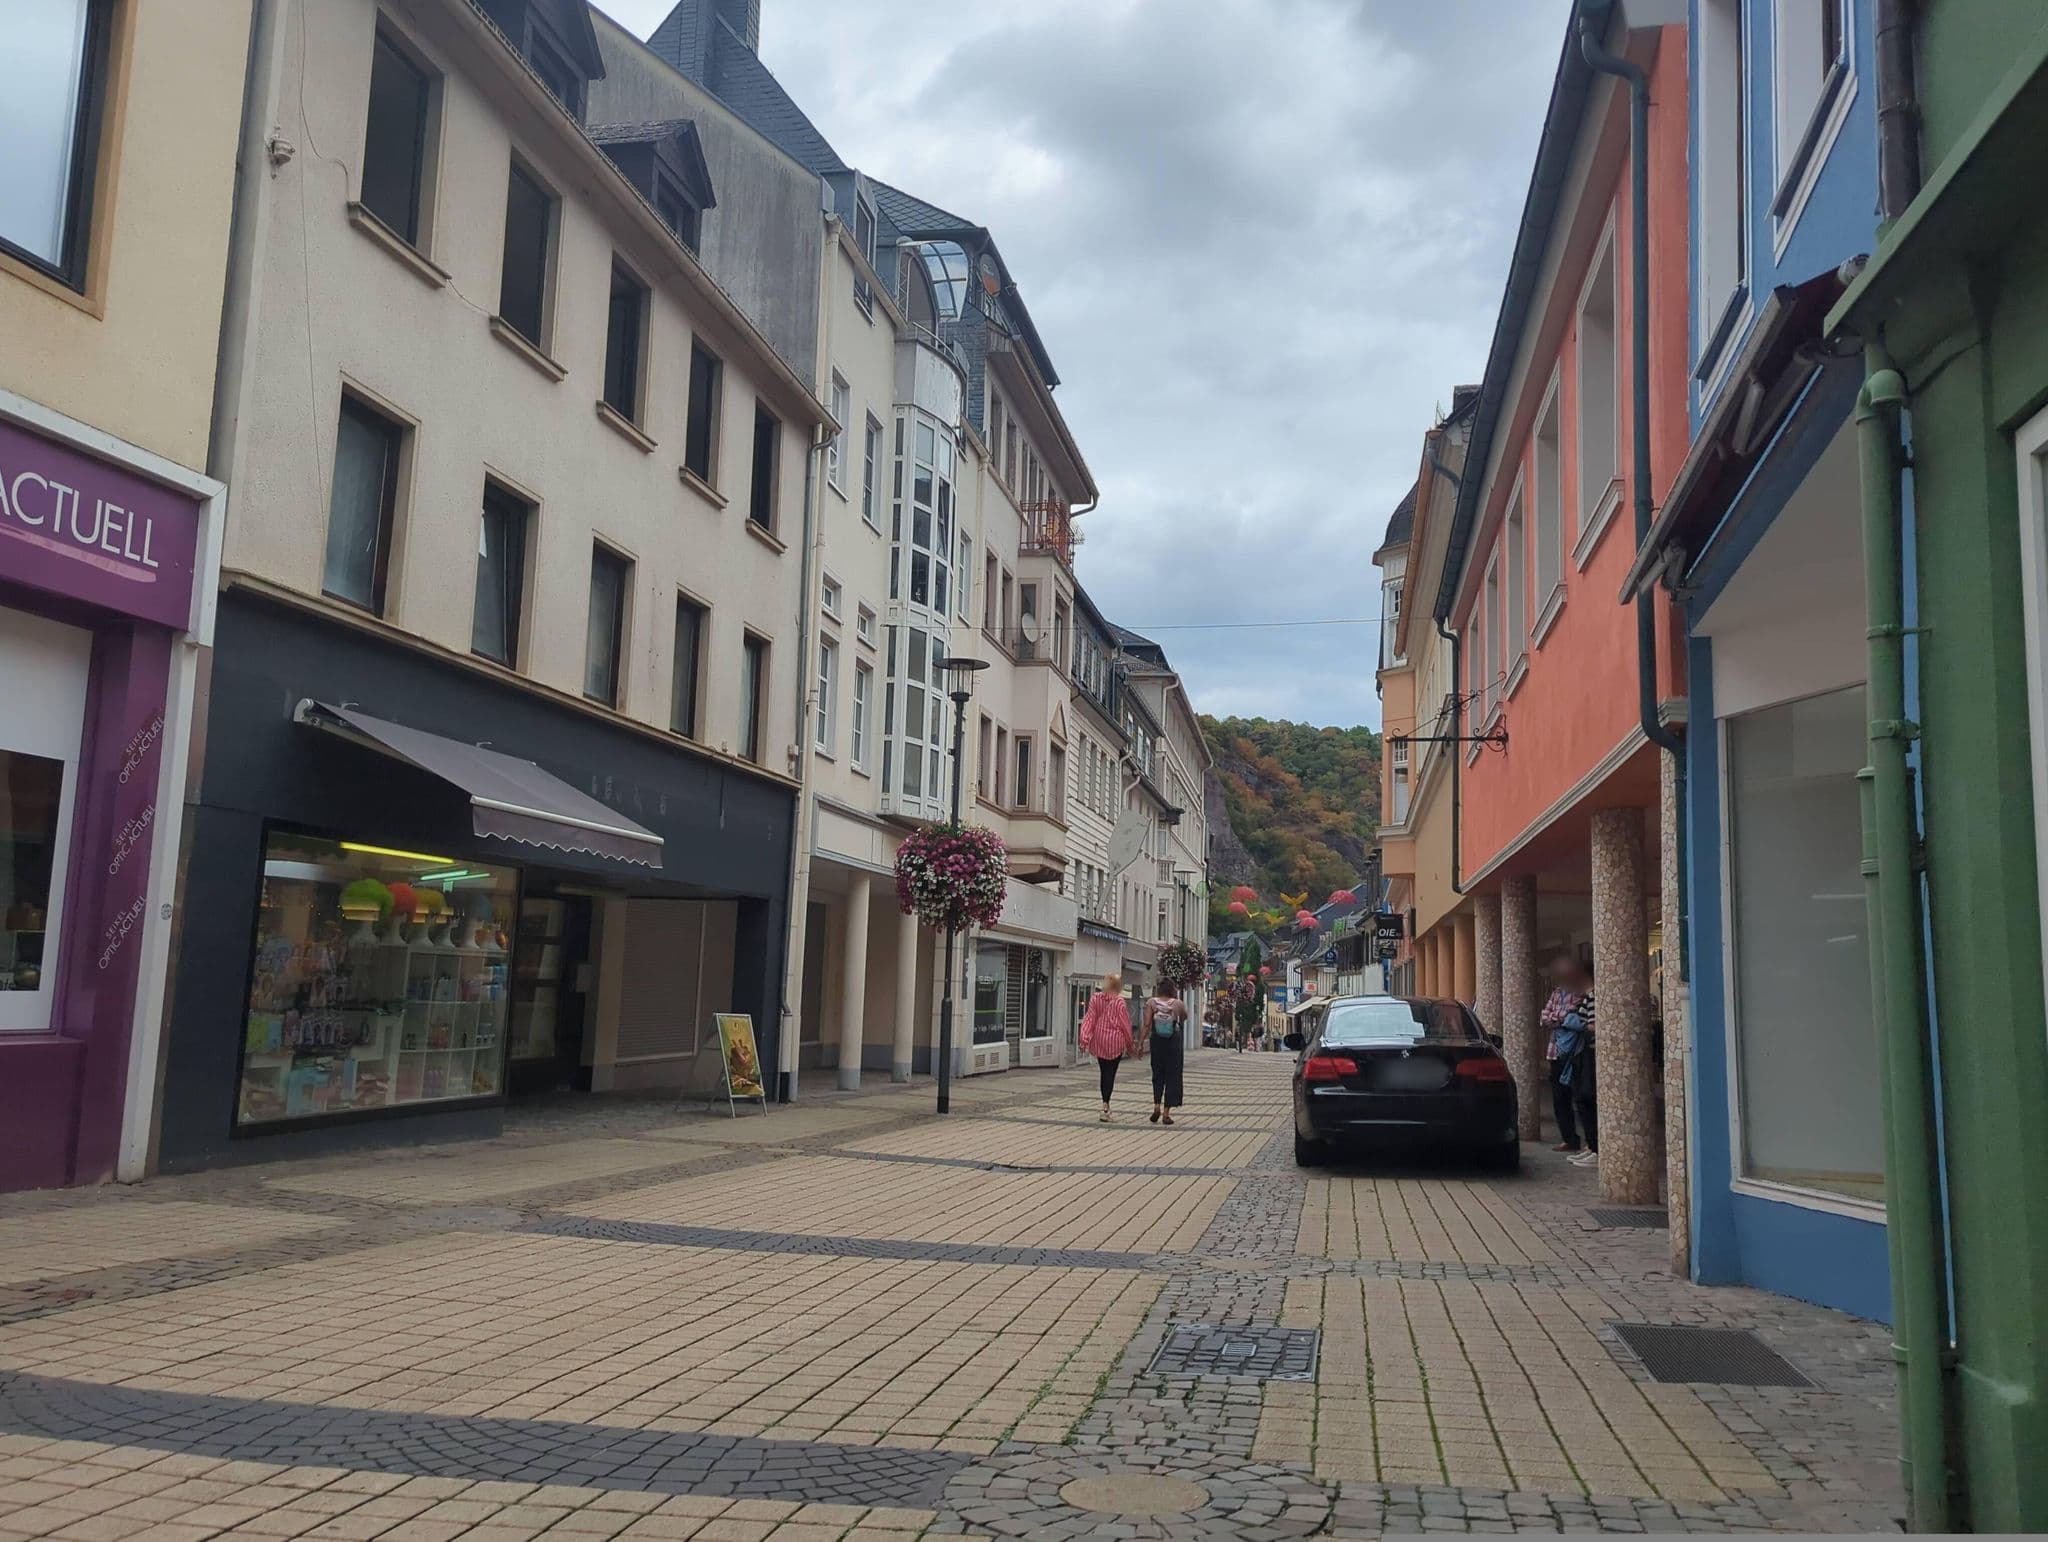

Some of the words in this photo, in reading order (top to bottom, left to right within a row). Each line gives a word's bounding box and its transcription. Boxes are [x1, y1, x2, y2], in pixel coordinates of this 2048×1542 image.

[119, 753, 141, 784] OPTIC
[139, 717, 164, 758] ACTUELL
[126, 729, 146, 756] SEIKEL
[109, 843, 131, 875] OPTIC
[129, 804, 156, 846] ACTUELL
[115, 818, 136, 845] SEIKEL
[99, 936, 121, 969] OPTIC
[119, 895, 146, 939] ACTUELL
[105, 911, 127, 939] SEIKEL
[1378, 928, 1396, 937] OIE
